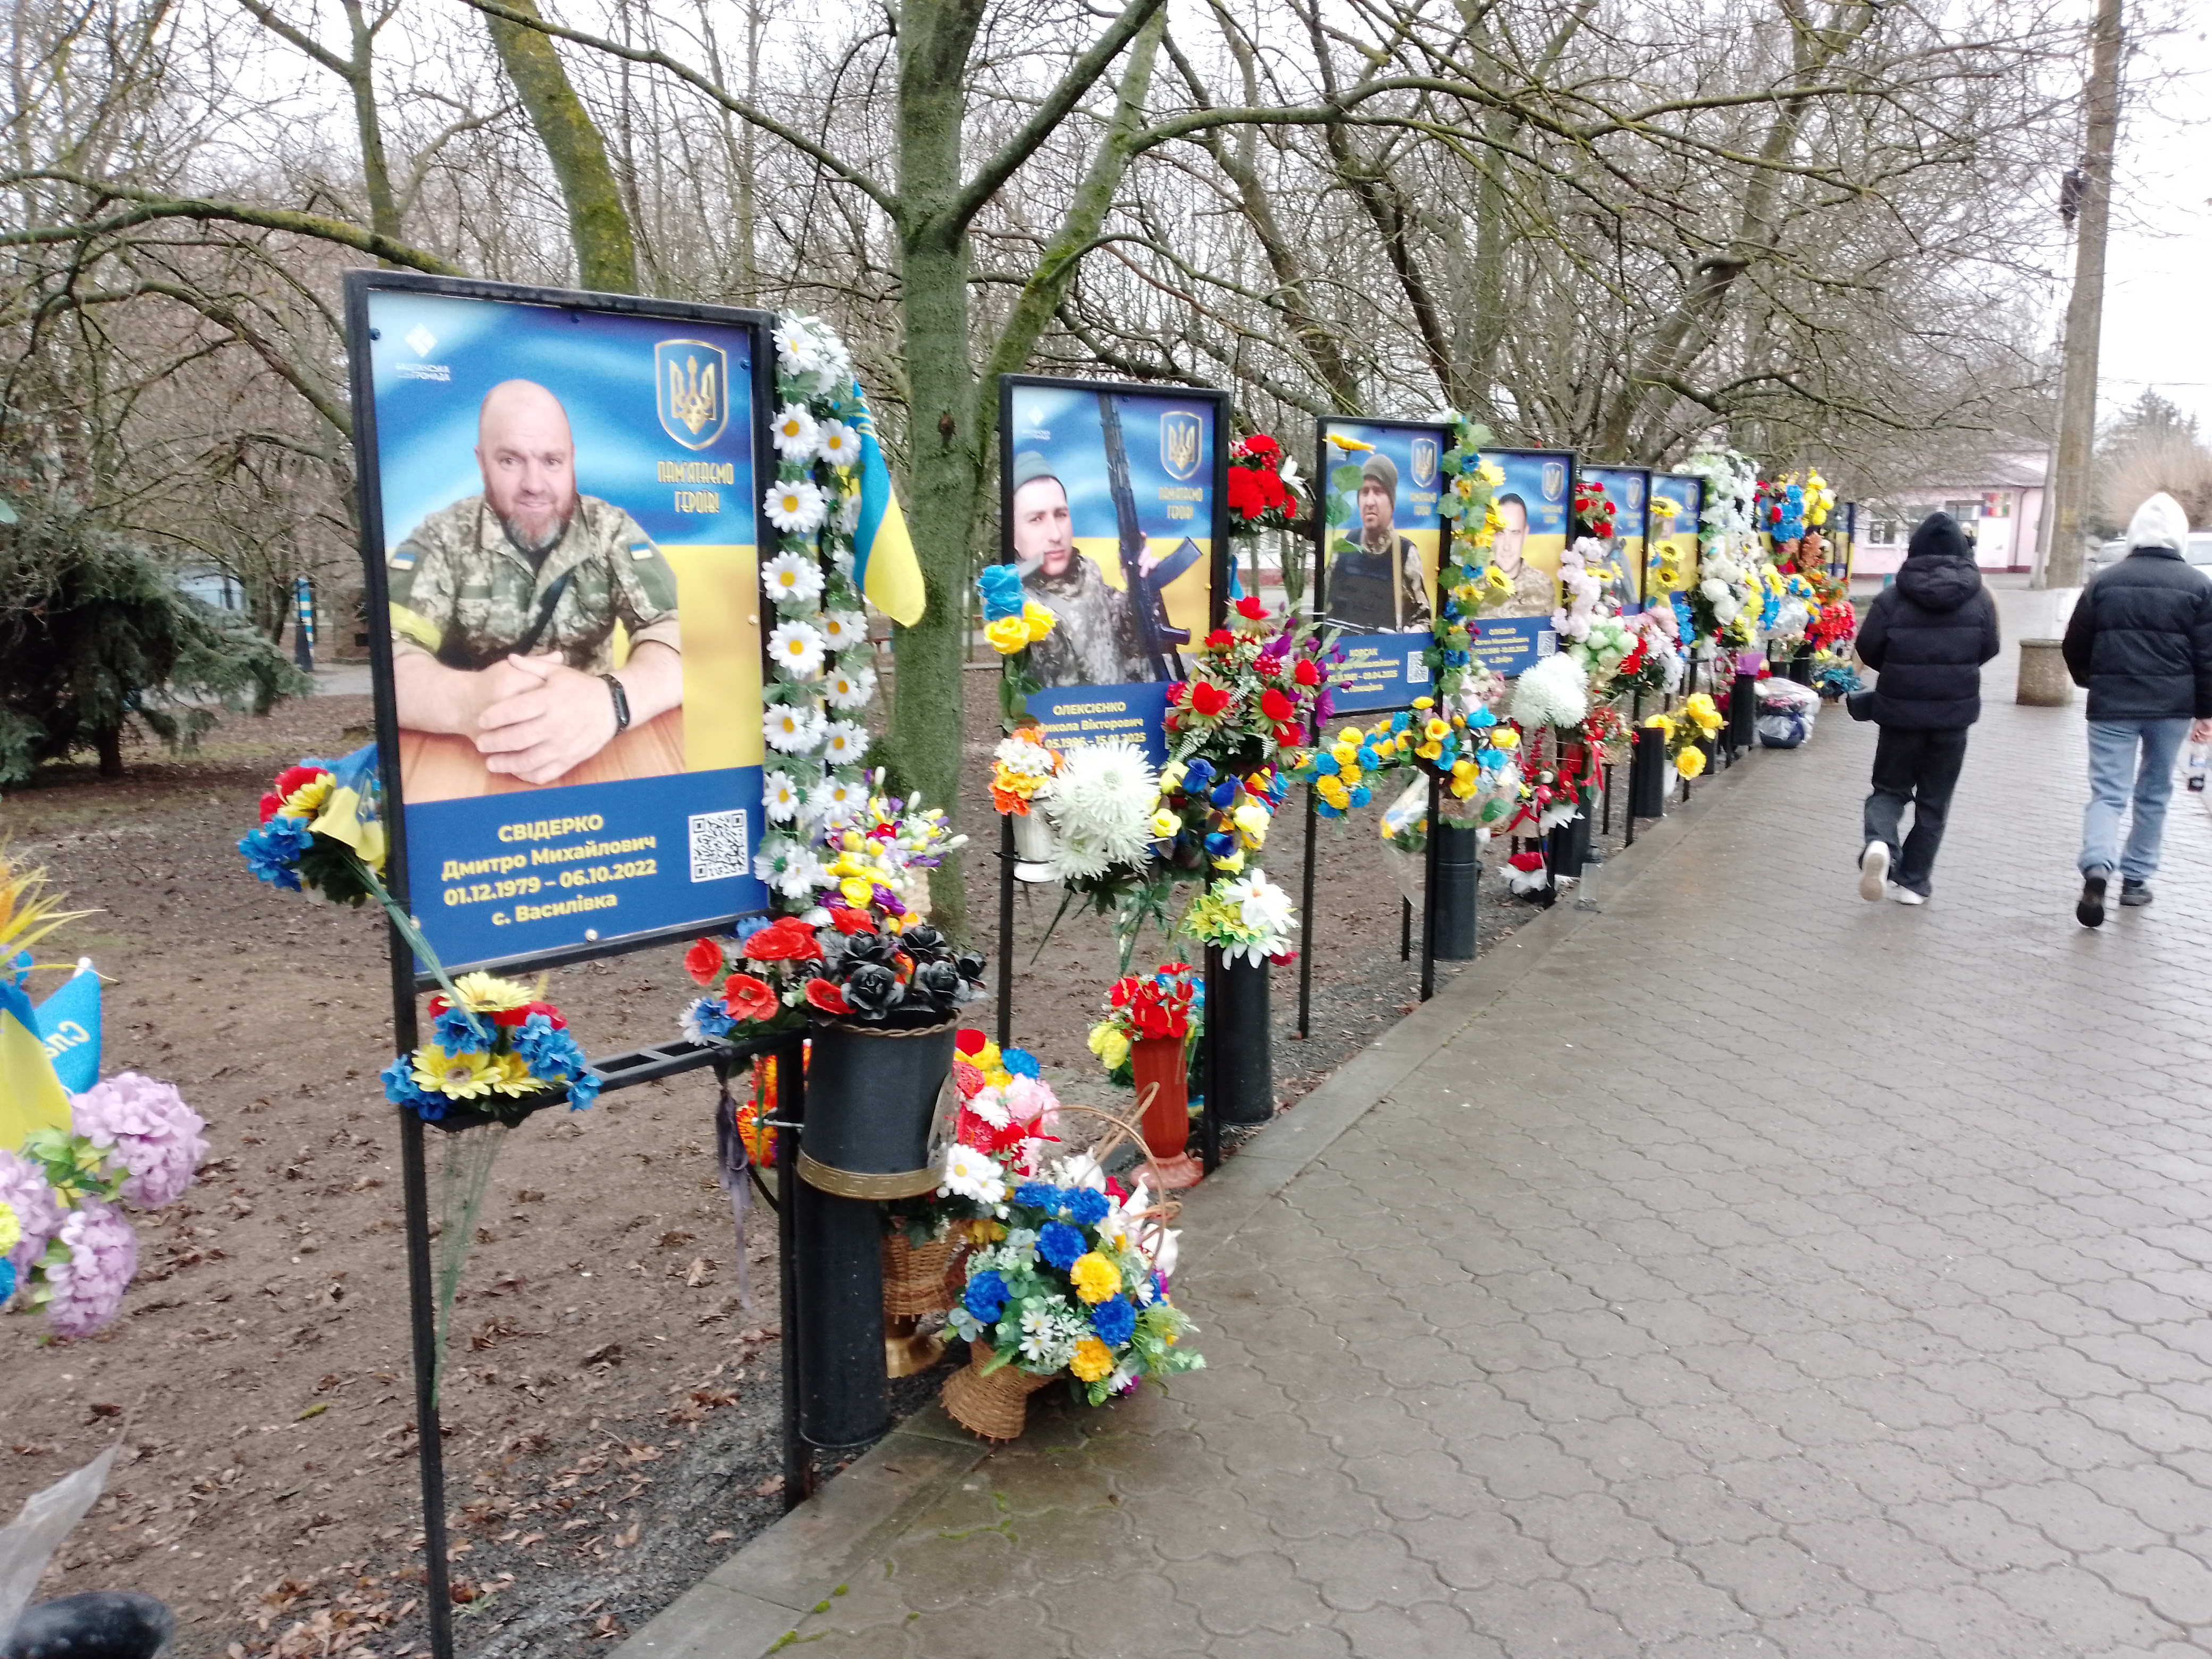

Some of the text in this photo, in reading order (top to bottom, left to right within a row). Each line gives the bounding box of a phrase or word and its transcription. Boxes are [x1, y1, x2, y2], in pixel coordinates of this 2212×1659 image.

[1053, 701, 1126, 716] ОЛЕКСІЄНКО
[498, 814, 604, 842] СВІДЕРКО
[441, 836, 656, 881] Дмитро Михайлович
[444, 876, 541, 906] 01.12.1979
[559, 859, 657, 887] 06.10.2022
[492, 893, 617, 926] с. Василівка
